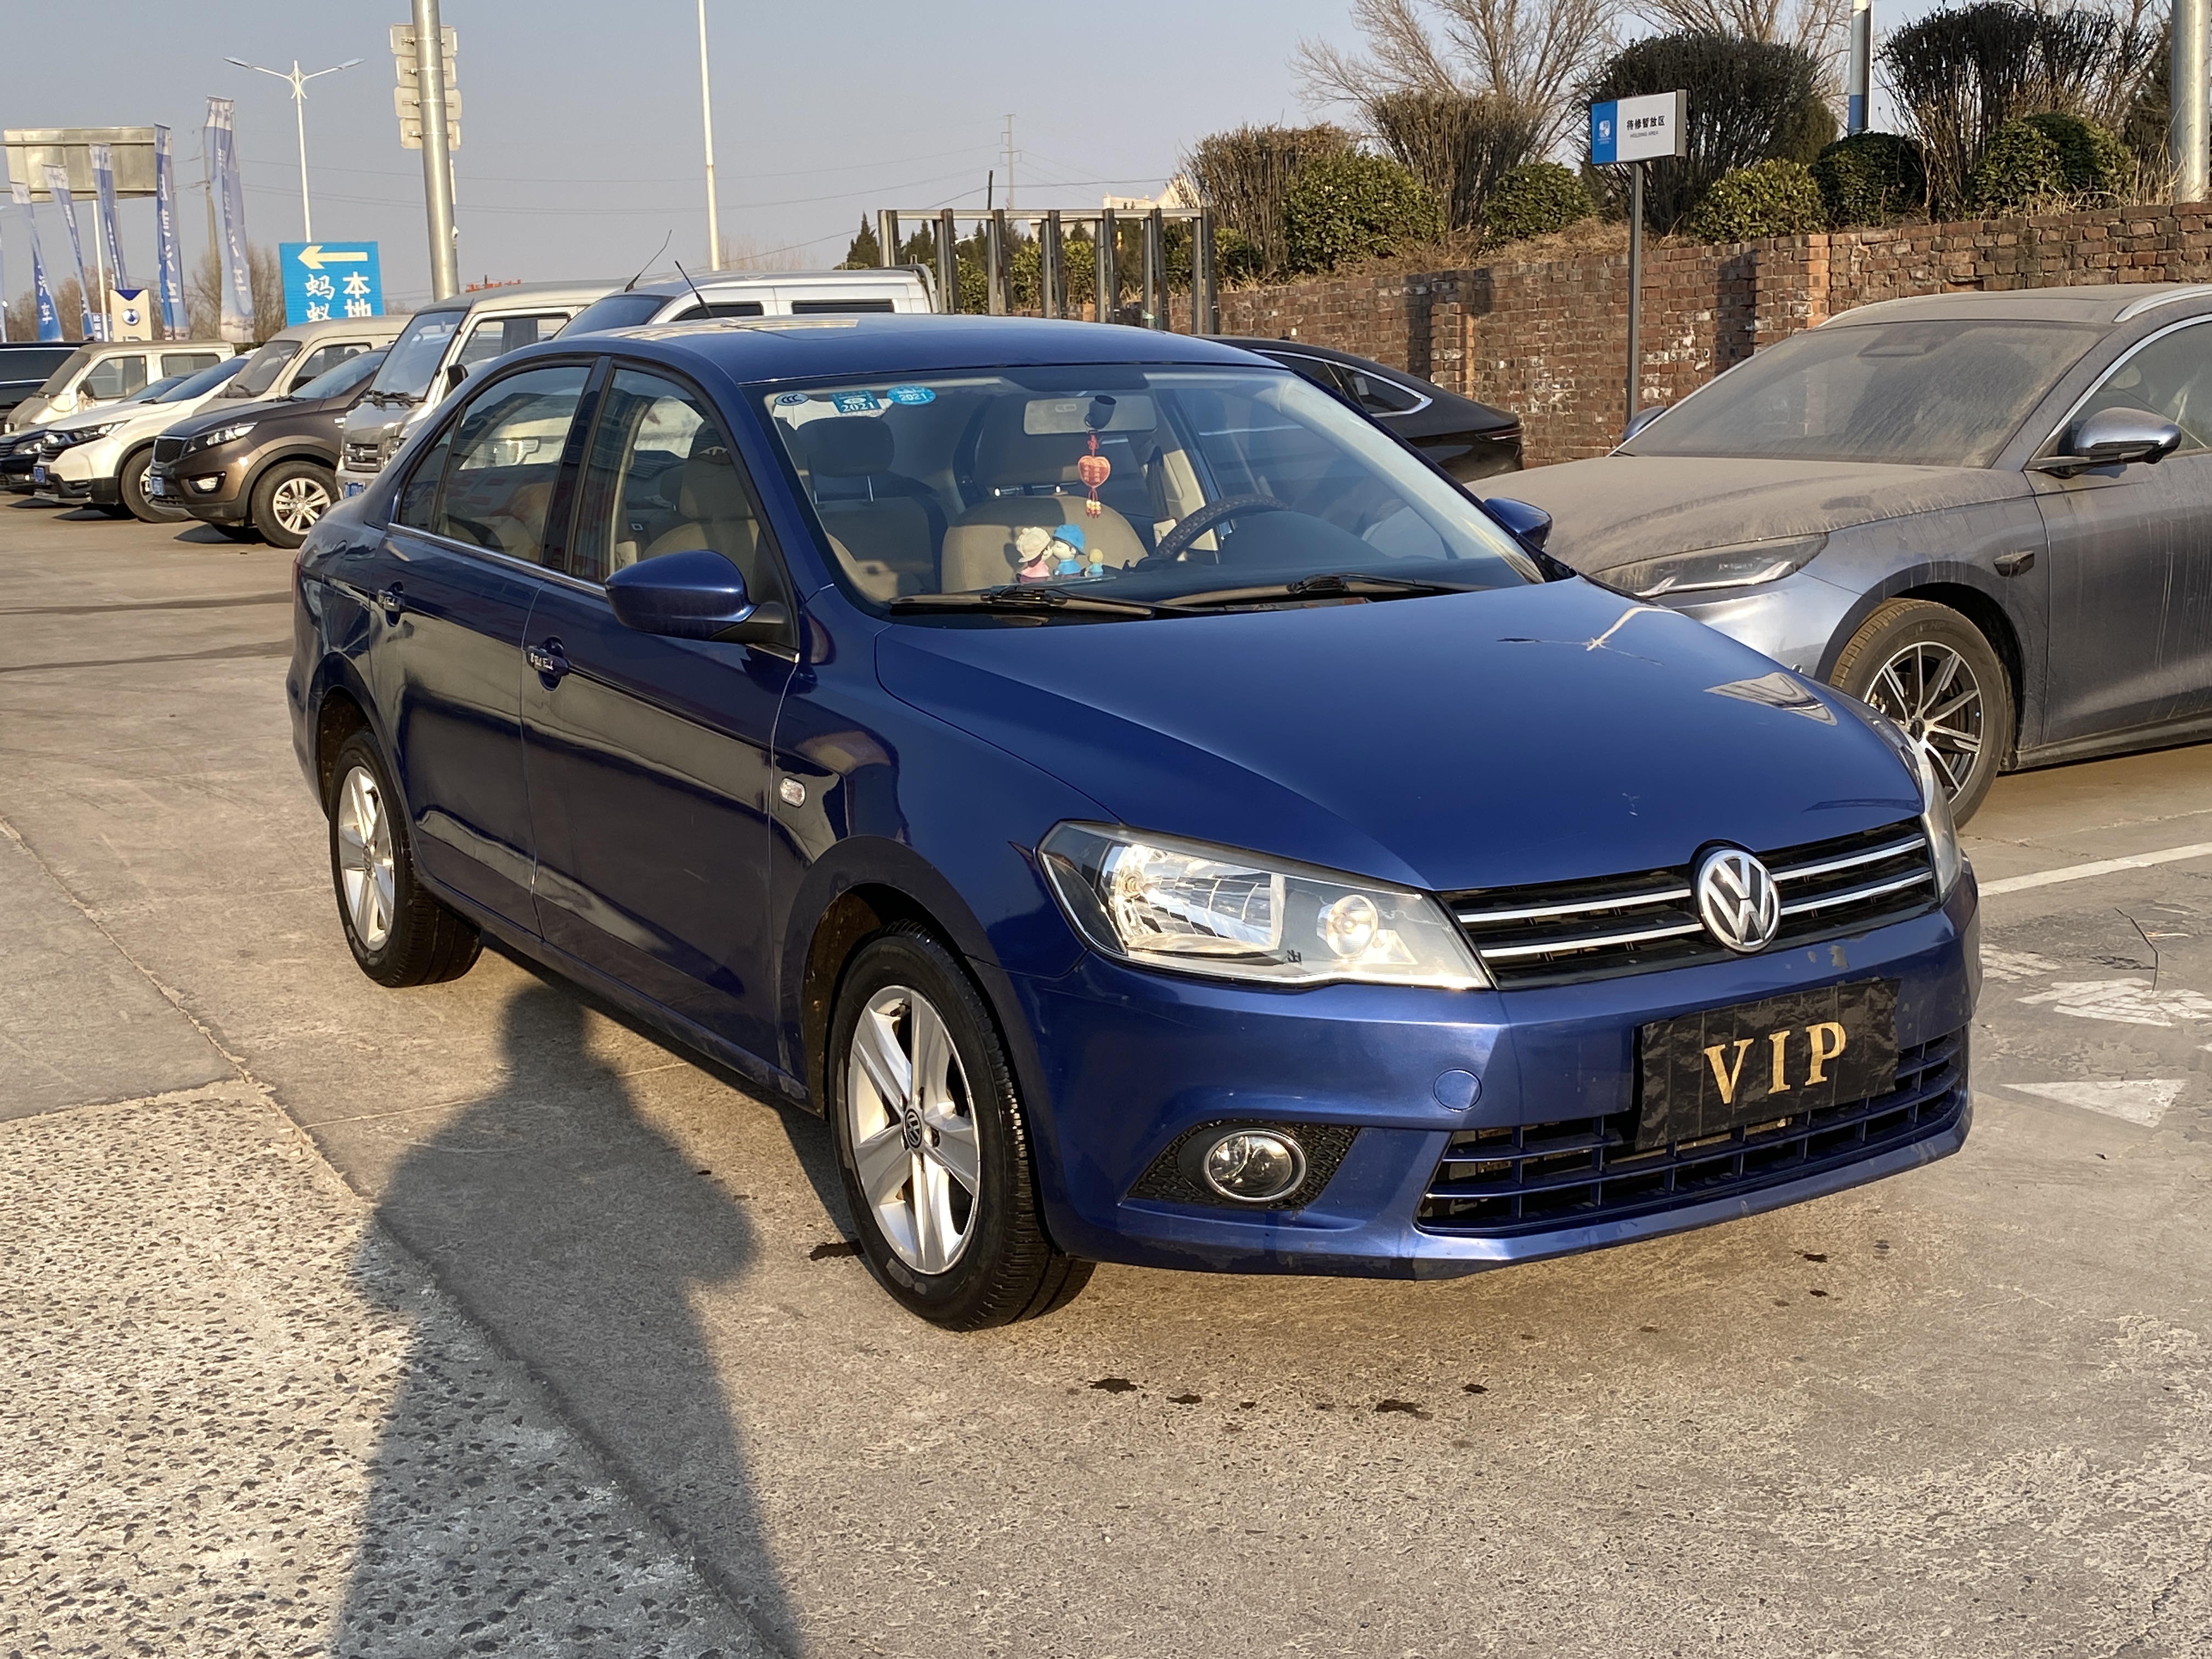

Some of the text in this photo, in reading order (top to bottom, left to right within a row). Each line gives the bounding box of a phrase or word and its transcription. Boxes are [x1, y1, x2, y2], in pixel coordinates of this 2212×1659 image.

[898, 393, 929, 401] 2021
[841, 402, 875, 412] 2021
[1703, 1021, 1847, 1104] VIP
